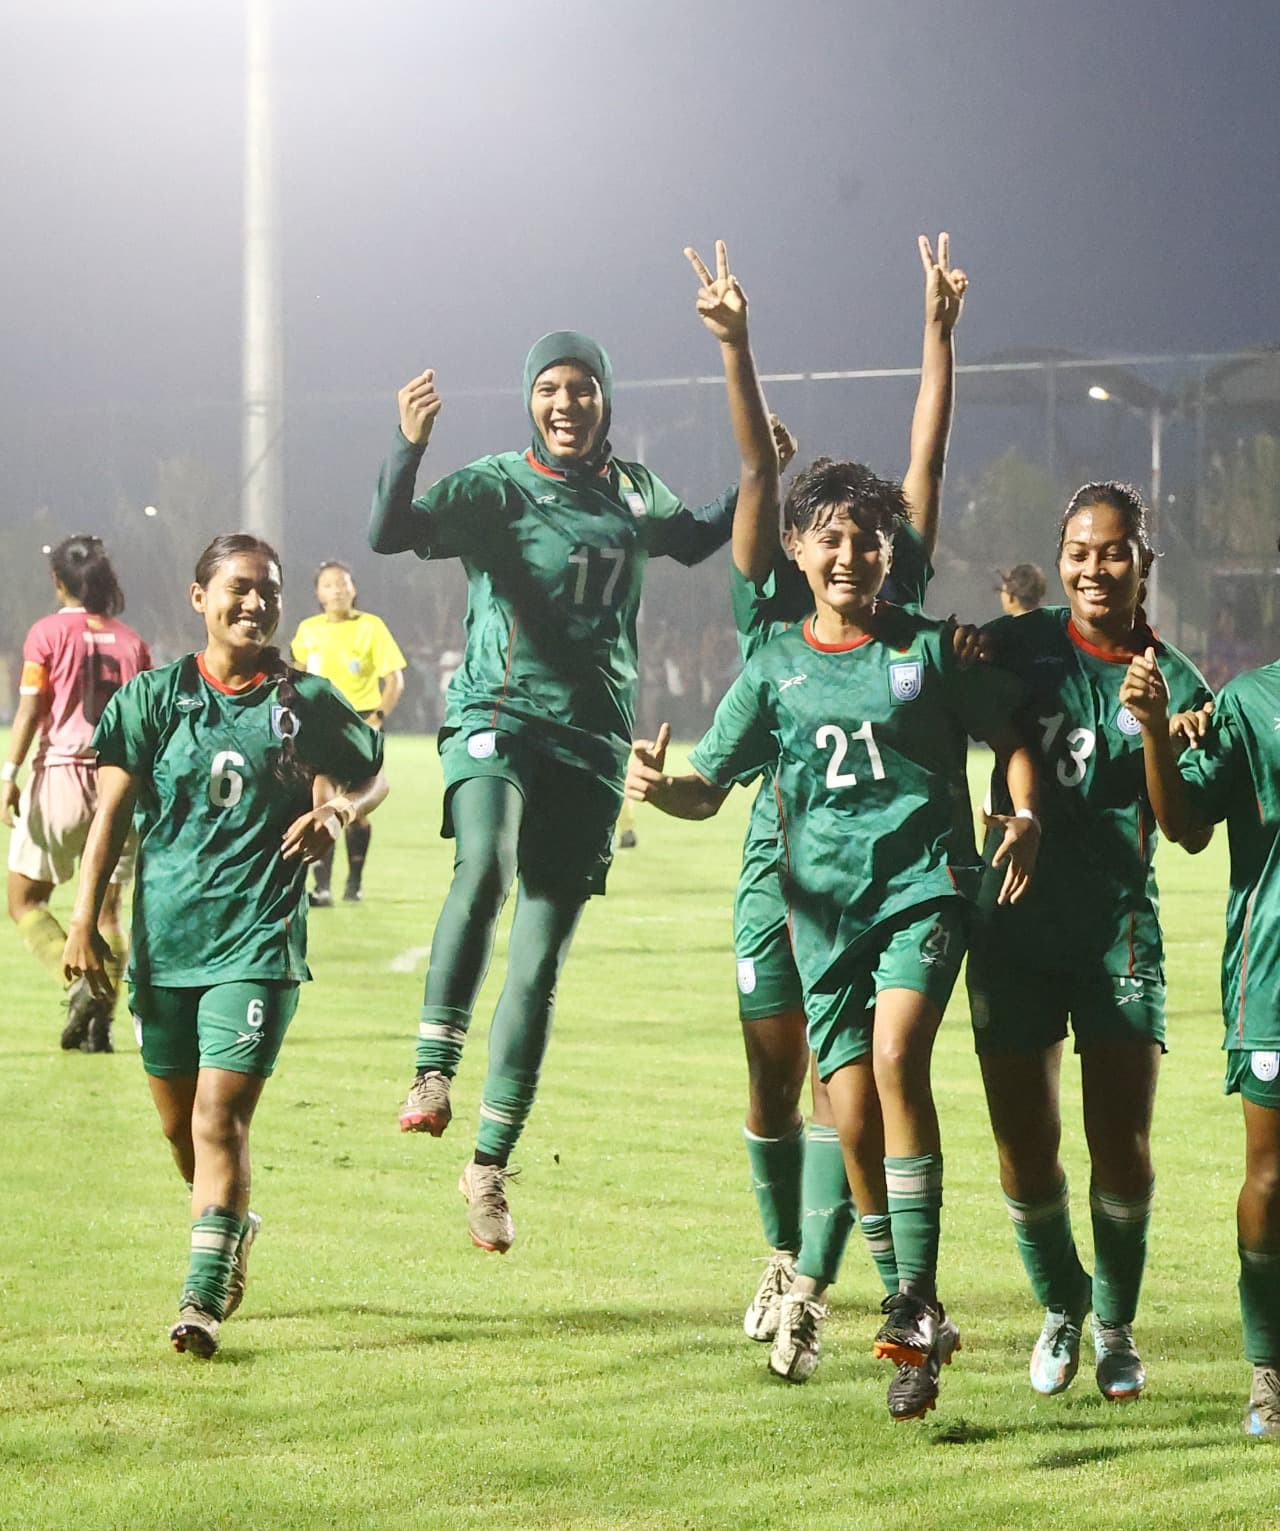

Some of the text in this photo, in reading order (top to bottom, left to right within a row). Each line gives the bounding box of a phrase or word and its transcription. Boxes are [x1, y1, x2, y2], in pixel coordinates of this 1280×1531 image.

[567, 546, 625, 606] 17
[815, 720, 886, 789] 21
[1038, 711, 1096, 787] 13
[209, 750, 244, 808] 6
[925, 921, 950, 956] 21
[246, 998, 264, 1027] 6
